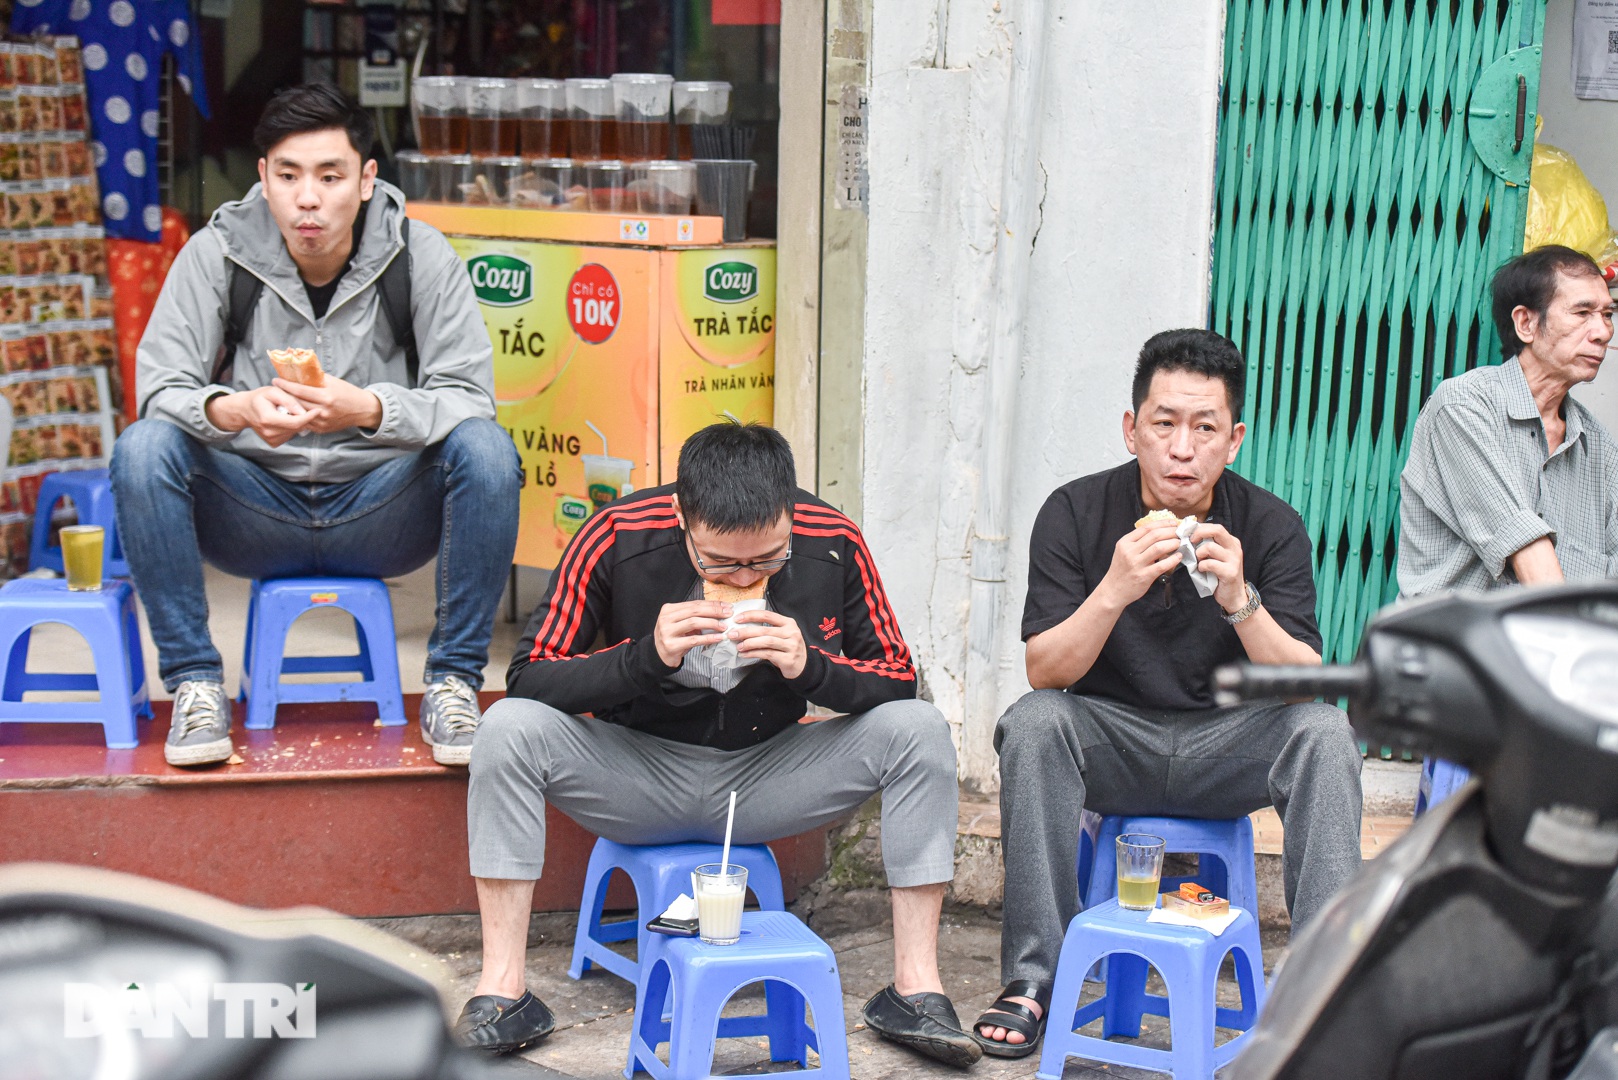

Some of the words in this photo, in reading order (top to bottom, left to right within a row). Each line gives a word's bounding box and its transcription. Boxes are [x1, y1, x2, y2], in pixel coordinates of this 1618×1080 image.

[844, 116, 861, 127] CHO
[471, 260, 526, 298] Cozy
[573, 282, 594, 296] Chỉ
[597, 284, 615, 298] có
[709, 267, 753, 295] Cozy
[573, 298, 616, 327] 10K
[694, 312, 730, 336] TRÀ
[737, 306, 773, 335] TẮC
[499, 317, 546, 358] TẮC
[685, 376, 707, 393] TRÀ
[712, 374, 746, 392] NHÂN
[523, 425, 581, 456] VÀNG
[824, 628, 841, 640] adidas
